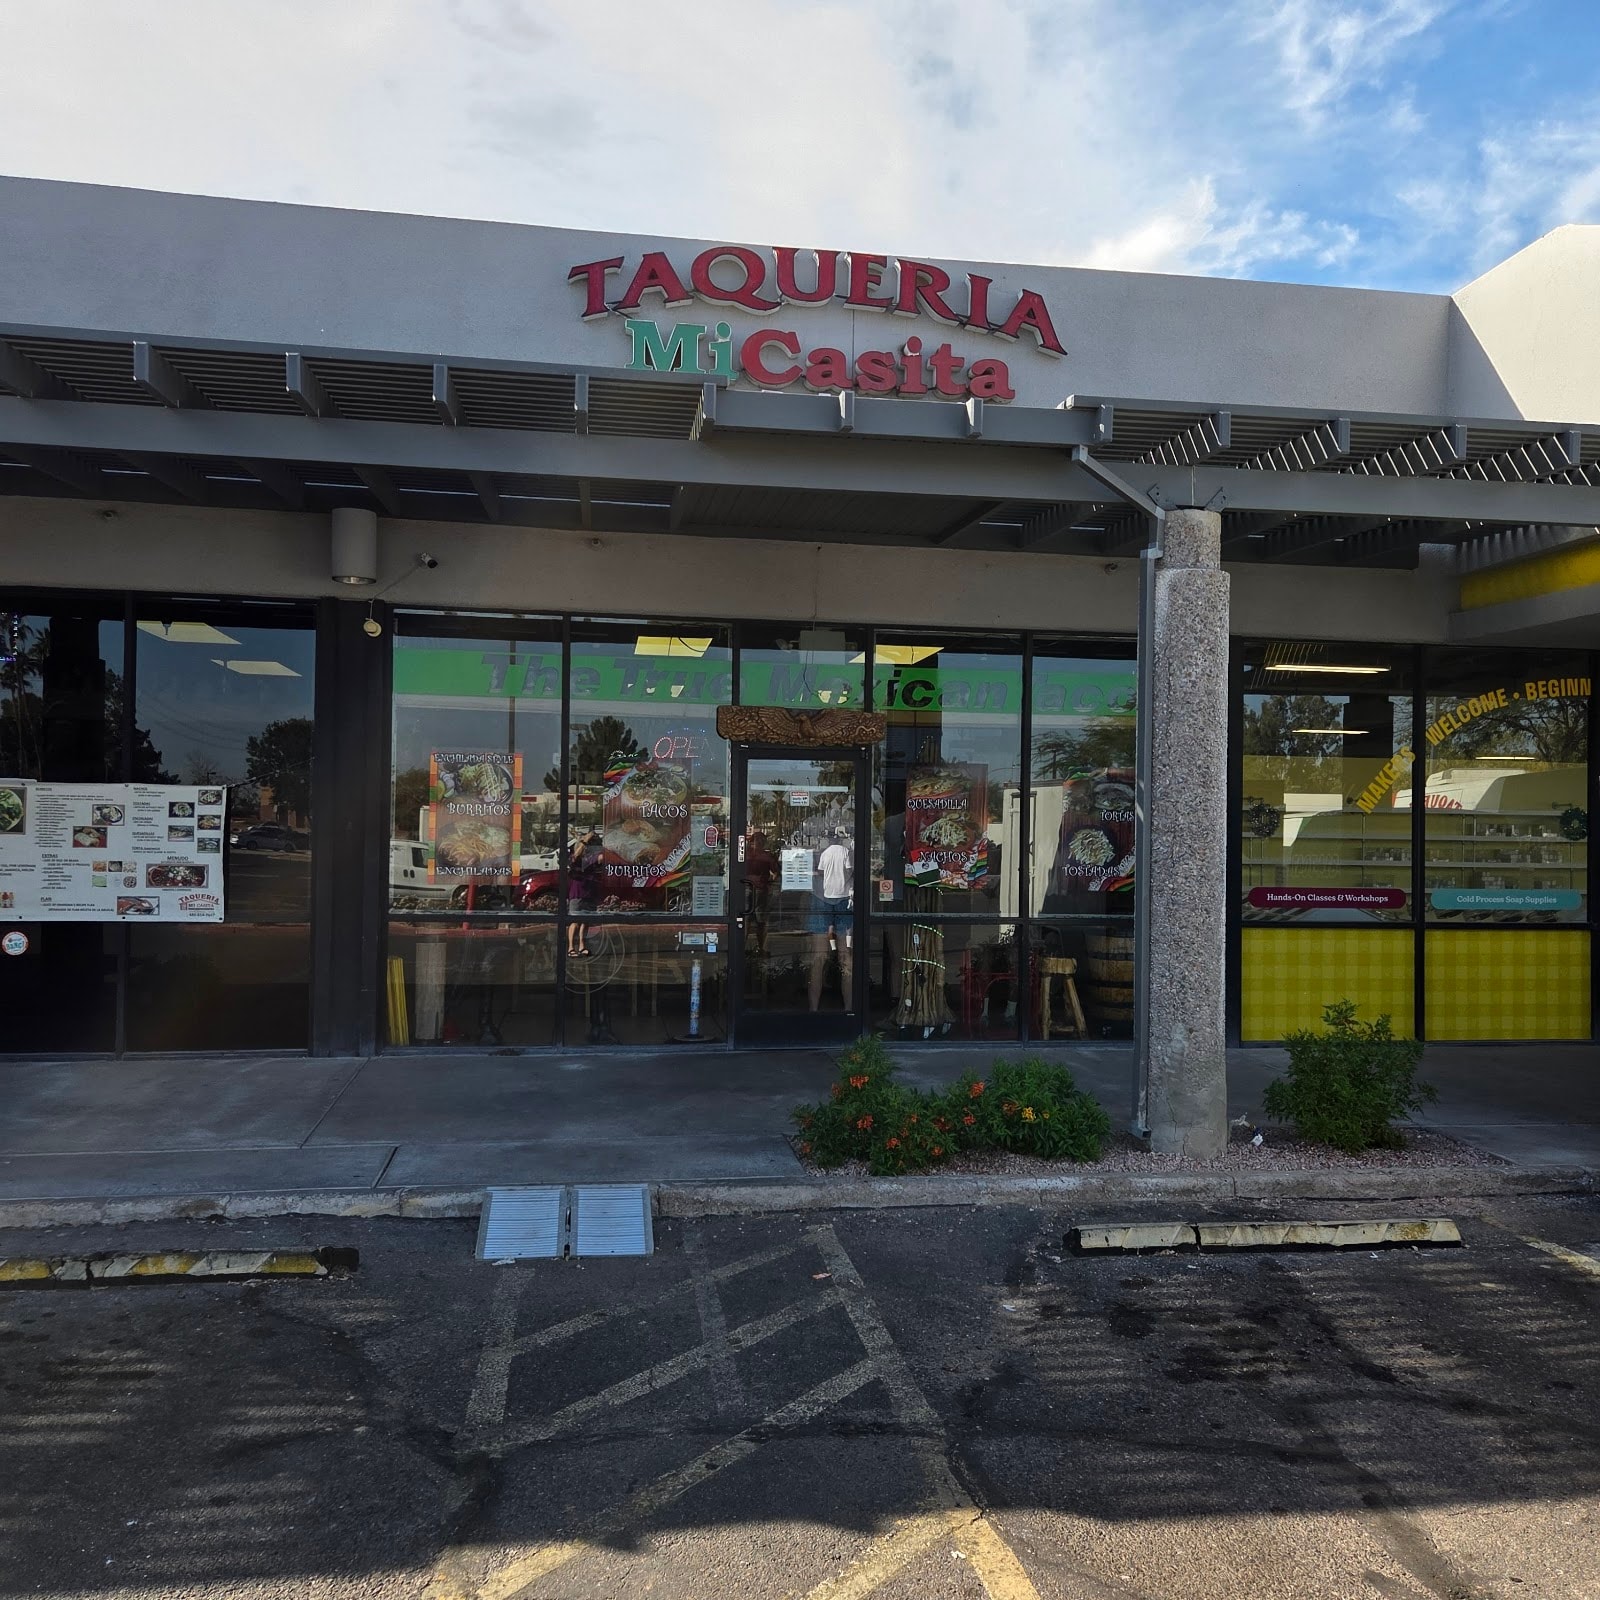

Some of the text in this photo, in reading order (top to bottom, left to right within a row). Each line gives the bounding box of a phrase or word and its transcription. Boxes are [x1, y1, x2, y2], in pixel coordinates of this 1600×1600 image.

[568, 246, 1067, 356] TAQUERIA
[625, 319, 1016, 401] Mi Casita
[482, 652, 600, 697] The
[1355, 746, 1416, 814] MAKERS
[1425, 688, 1509, 746] WELCOME
[447, 802, 511, 817] BURRITOS
[639, 801, 688, 818] TACOS
[907, 798, 968, 811] QUESADILLA
[917, 851, 968, 864] NACHOS
[436, 866, 513, 877] ENCHILADAS
[606, 864, 667, 878] BURRITOS
[1062, 864, 1121, 877] TOSTADAS
[178, 893, 220, 905] TAQUERIA
[1266, 893, 1389, 904] Hands-On Classes & Workshops
[1456, 895, 1557, 906] Cold Process Soap Supplies
